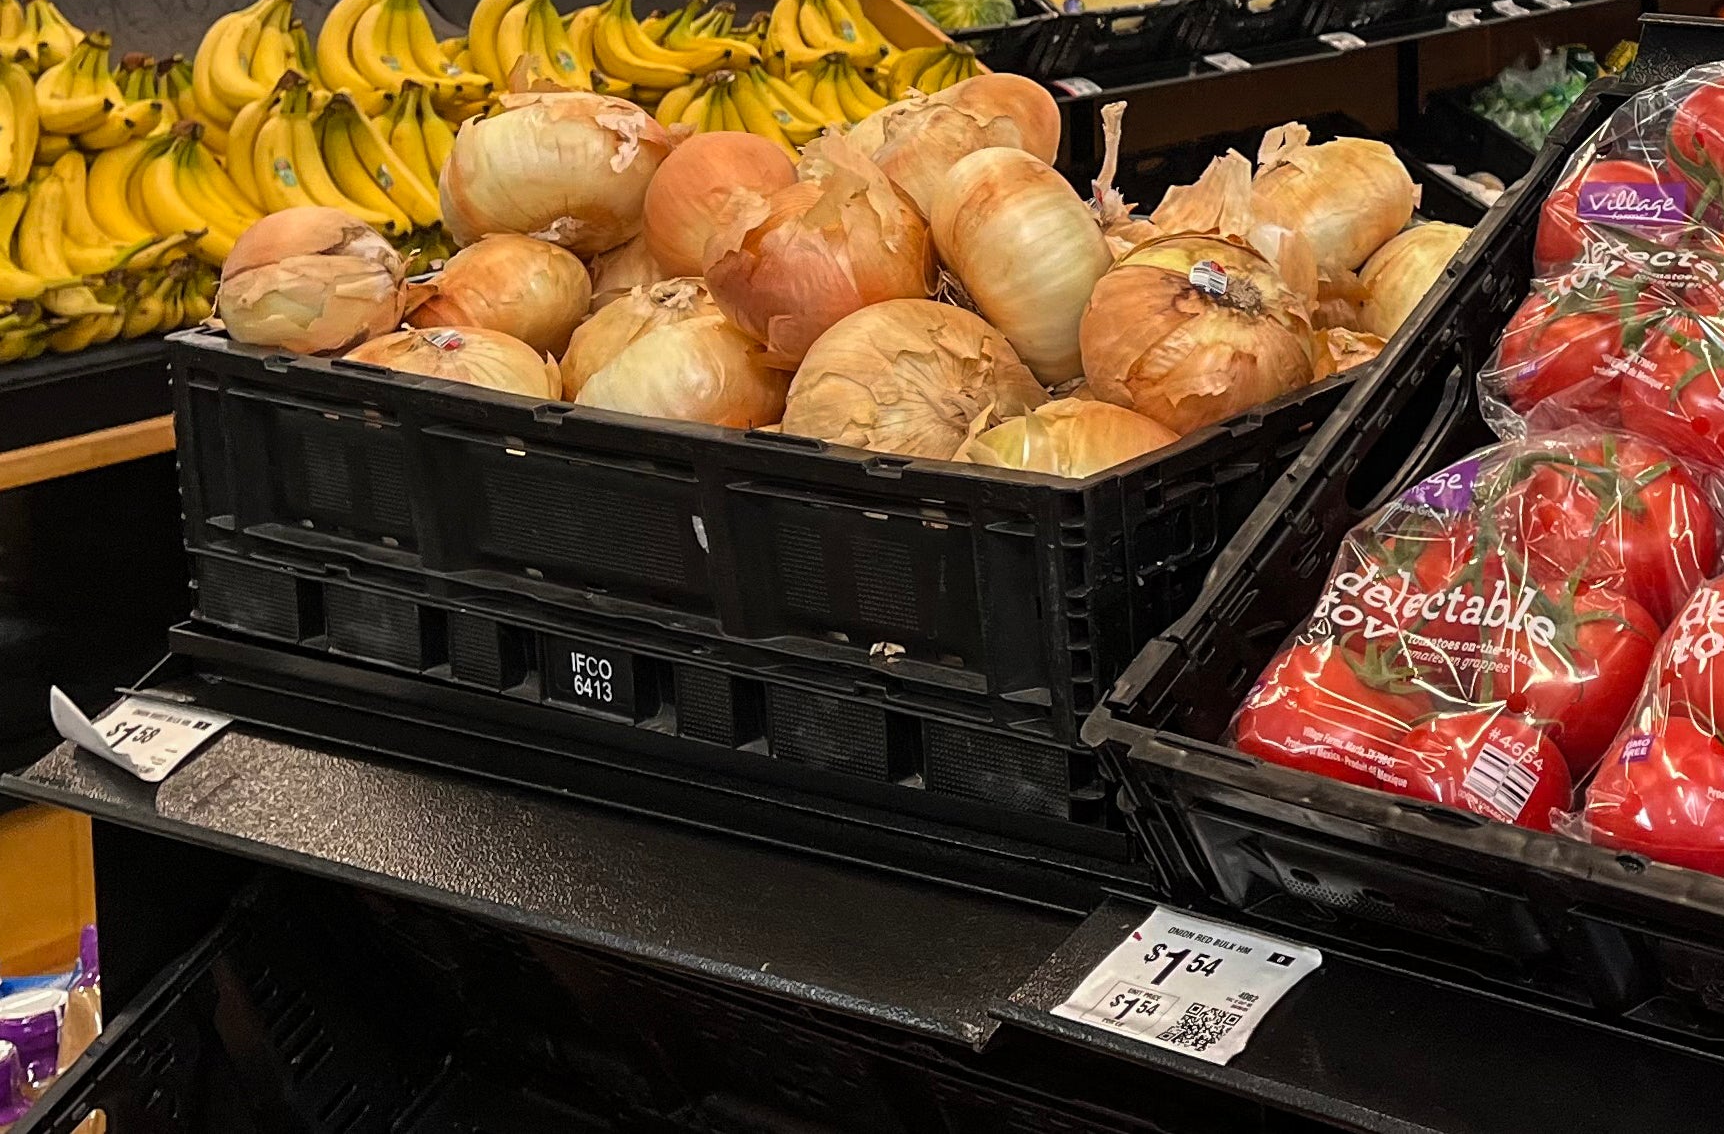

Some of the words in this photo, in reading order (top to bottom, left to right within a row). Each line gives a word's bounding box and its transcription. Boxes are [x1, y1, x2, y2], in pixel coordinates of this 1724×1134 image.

[1589, 189, 1676, 219] Village
[1313, 591, 1400, 640] tov
[1334, 563, 1557, 648] delectable
[570, 651, 613, 681] IFCO
[1460, 657, 1512, 675] grappes
[573, 673, 613, 703] 6413
[1487, 726, 1545, 773] #4664
[1167, 926, 1196, 941] ONION
[1196, 932, 1213, 945] RED
[1213, 937, 1237, 950] BULK
